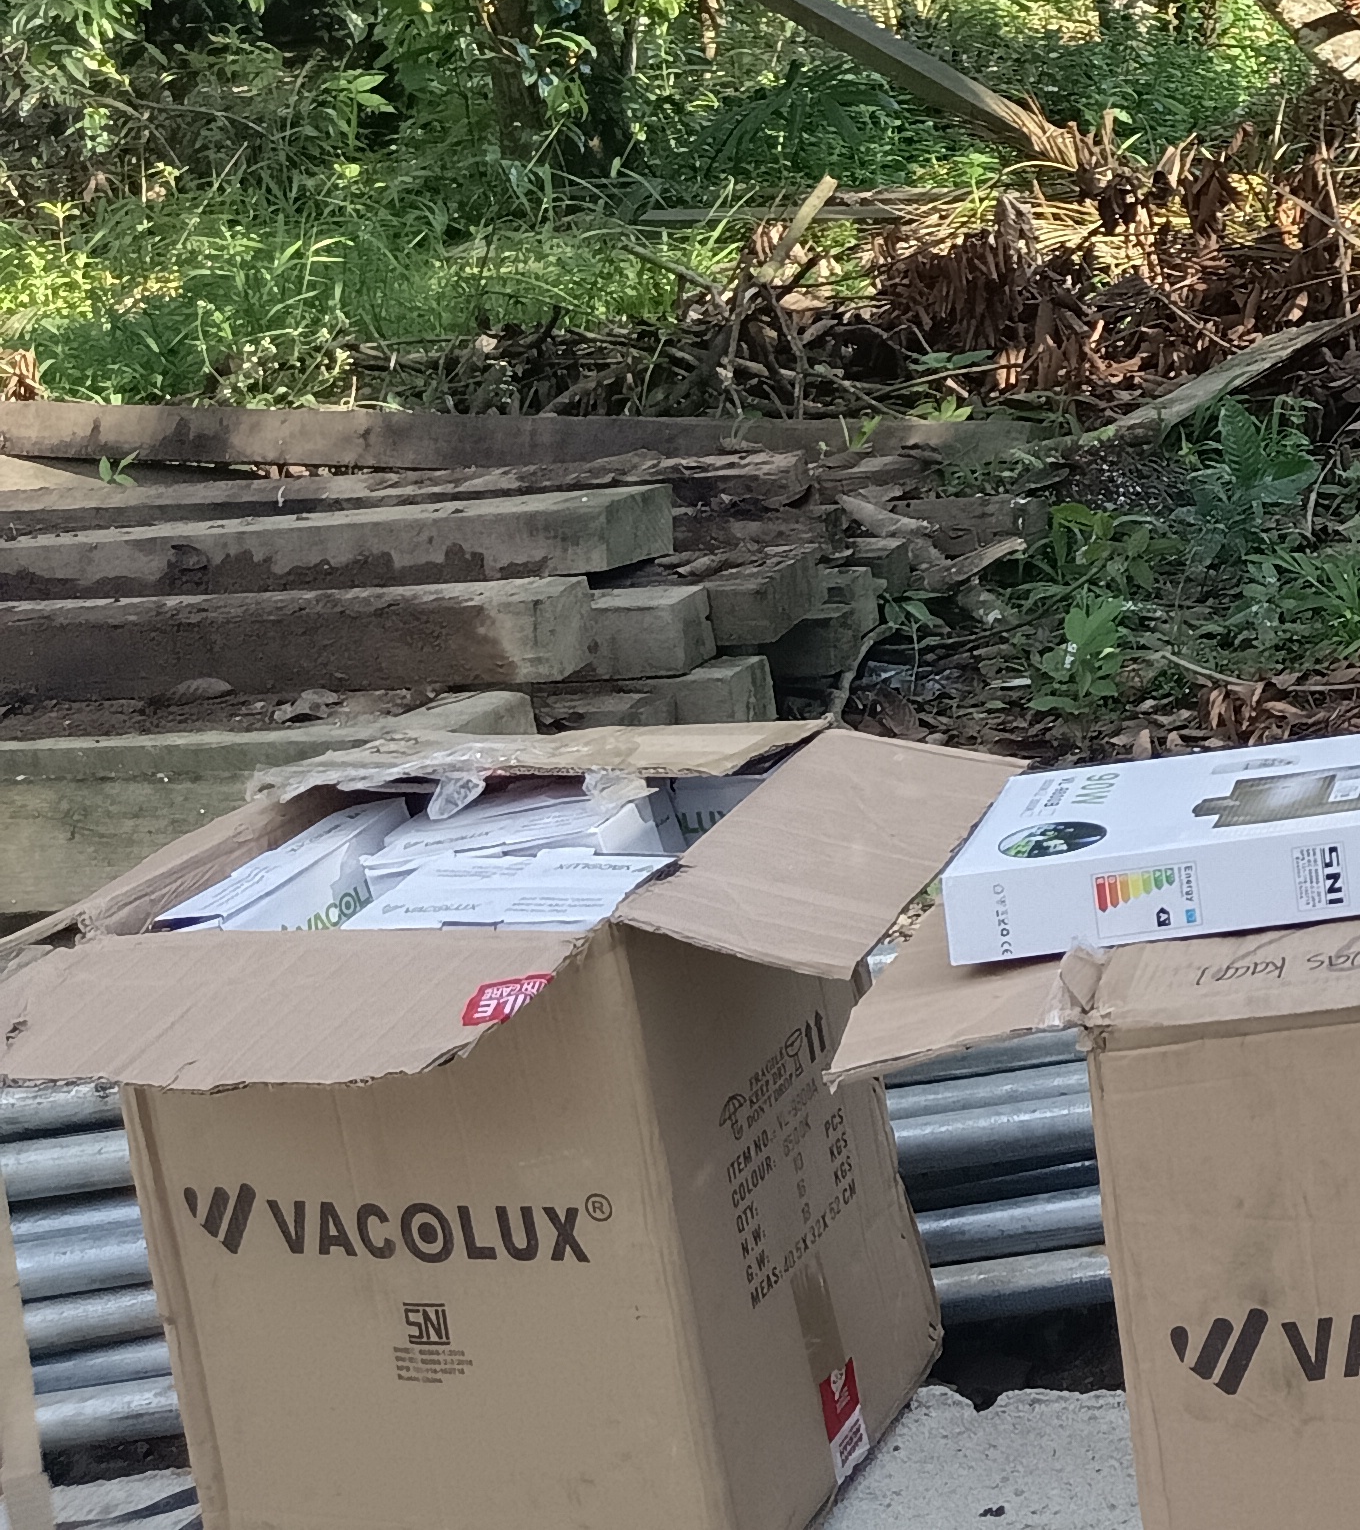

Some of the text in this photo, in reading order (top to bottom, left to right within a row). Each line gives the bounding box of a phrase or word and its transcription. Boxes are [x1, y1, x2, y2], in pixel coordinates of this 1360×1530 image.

[1071, 773, 1120, 804] 90W
[1184, 865, 1195, 902] Energy
[1324, 846, 1344, 905] SNI
[824, 1107, 844, 1139] PCS
[829, 1132, 848, 1163] KGS
[727, 1146, 752, 1183] ITEM
[833, 1155, 852, 1187] KGS
[404, 1308, 450, 1340] SNI
